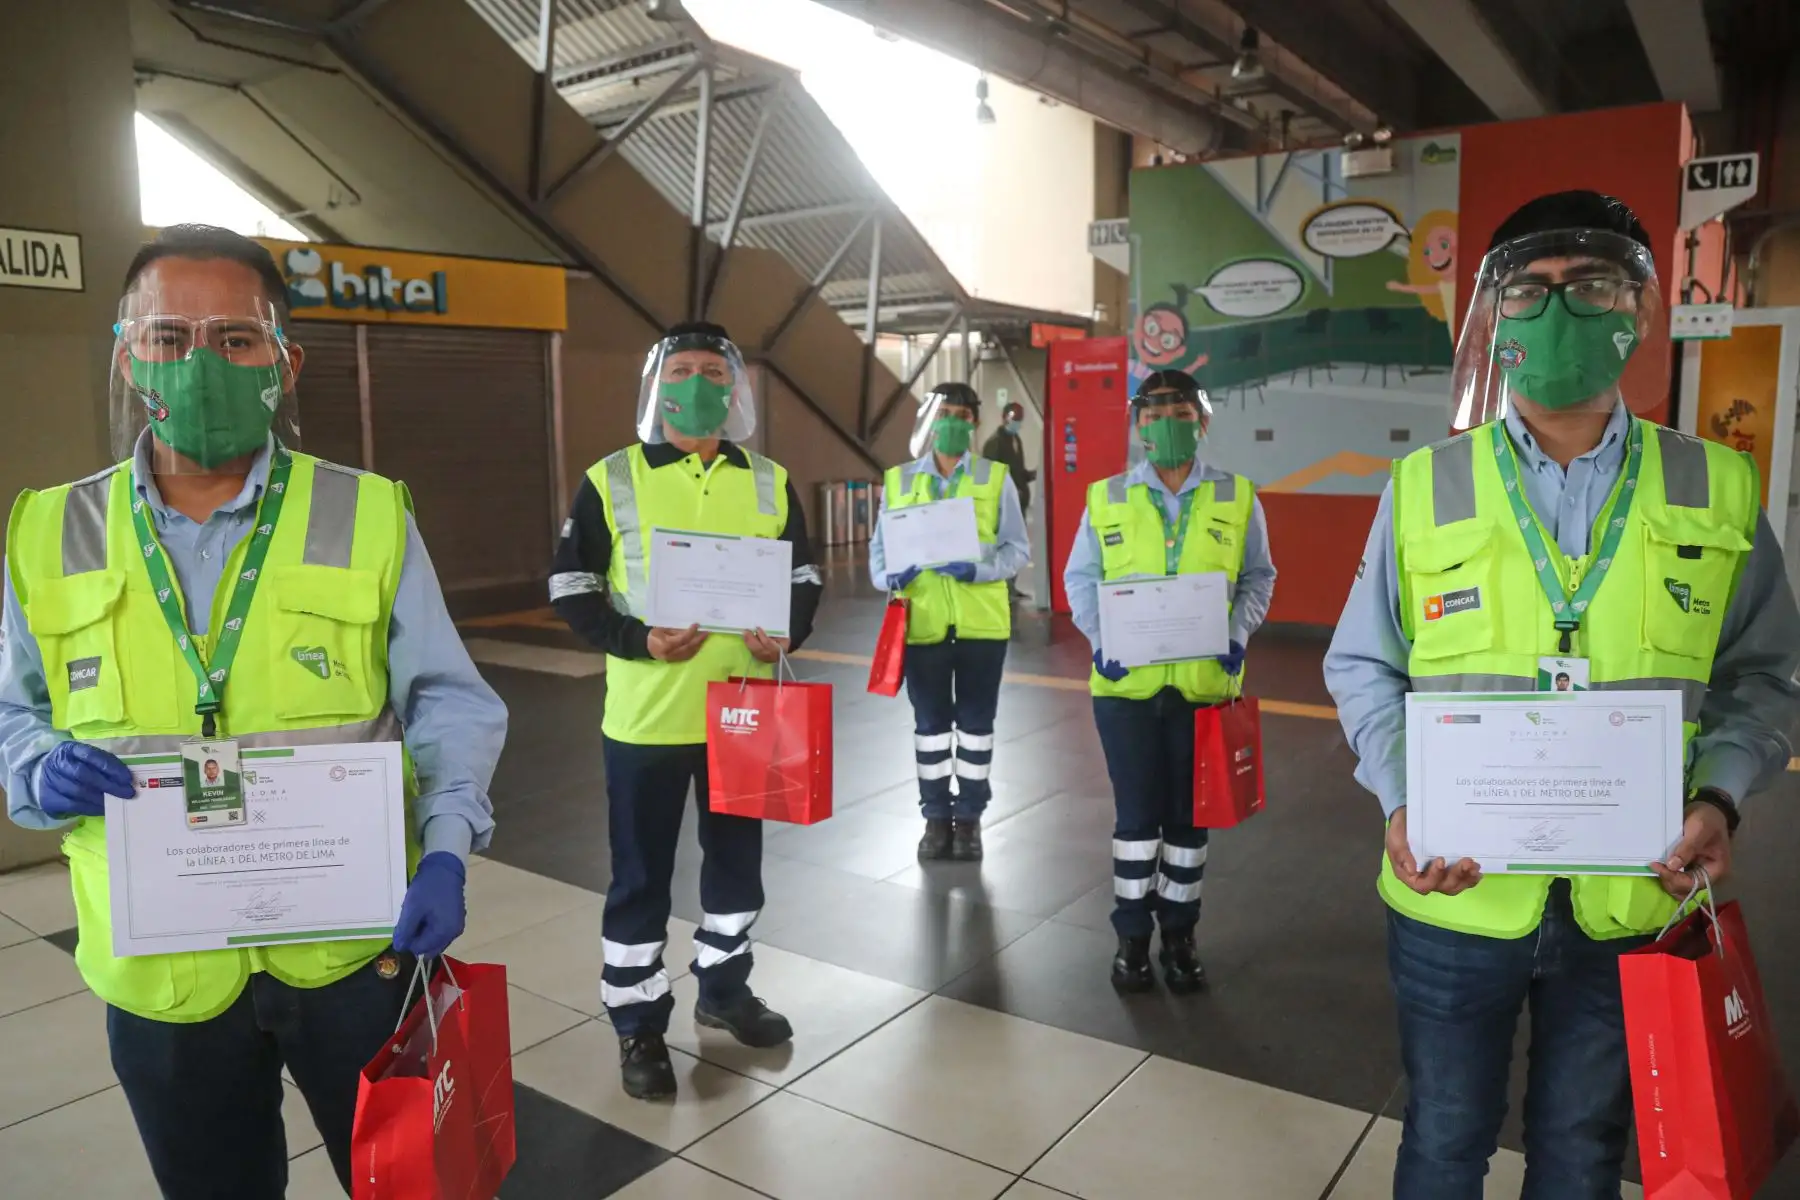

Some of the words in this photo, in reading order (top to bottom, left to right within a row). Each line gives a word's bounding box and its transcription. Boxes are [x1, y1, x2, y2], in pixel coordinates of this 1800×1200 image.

[329, 261, 447, 314] bitel
[1445, 595, 1475, 608] CONCAR
[721, 707, 760, 726] MTC
[1456, 778, 1471, 786] Los
[1473, 777, 1537, 786] colaboradores
[1539, 777, 1550, 786] de
[1553, 777, 1587, 788] primera
[1614, 777, 1626, 786] de
[203, 790, 224, 798] KEVIN
[1520, 789, 1536, 797] DEL
[1540, 789, 1571, 798] METRO
[1574, 790, 1587, 798] DE
[1589, 789, 1611, 798] LIMA
[166, 847, 184, 856] Los
[186, 842, 256, 855] colaboradores
[258, 841, 271, 850] de
[273, 839, 309, 852] primera
[338, 836, 350, 846] de
[186, 858, 196, 867] la
[198, 855, 226, 866] LÍNEA
[230, 856, 235, 864] 1
[238, 854, 257, 864] DEL
[260, 852, 293, 863] METRO
[296, 851, 310, 860] DE
[312, 850, 335, 859] LIMA
